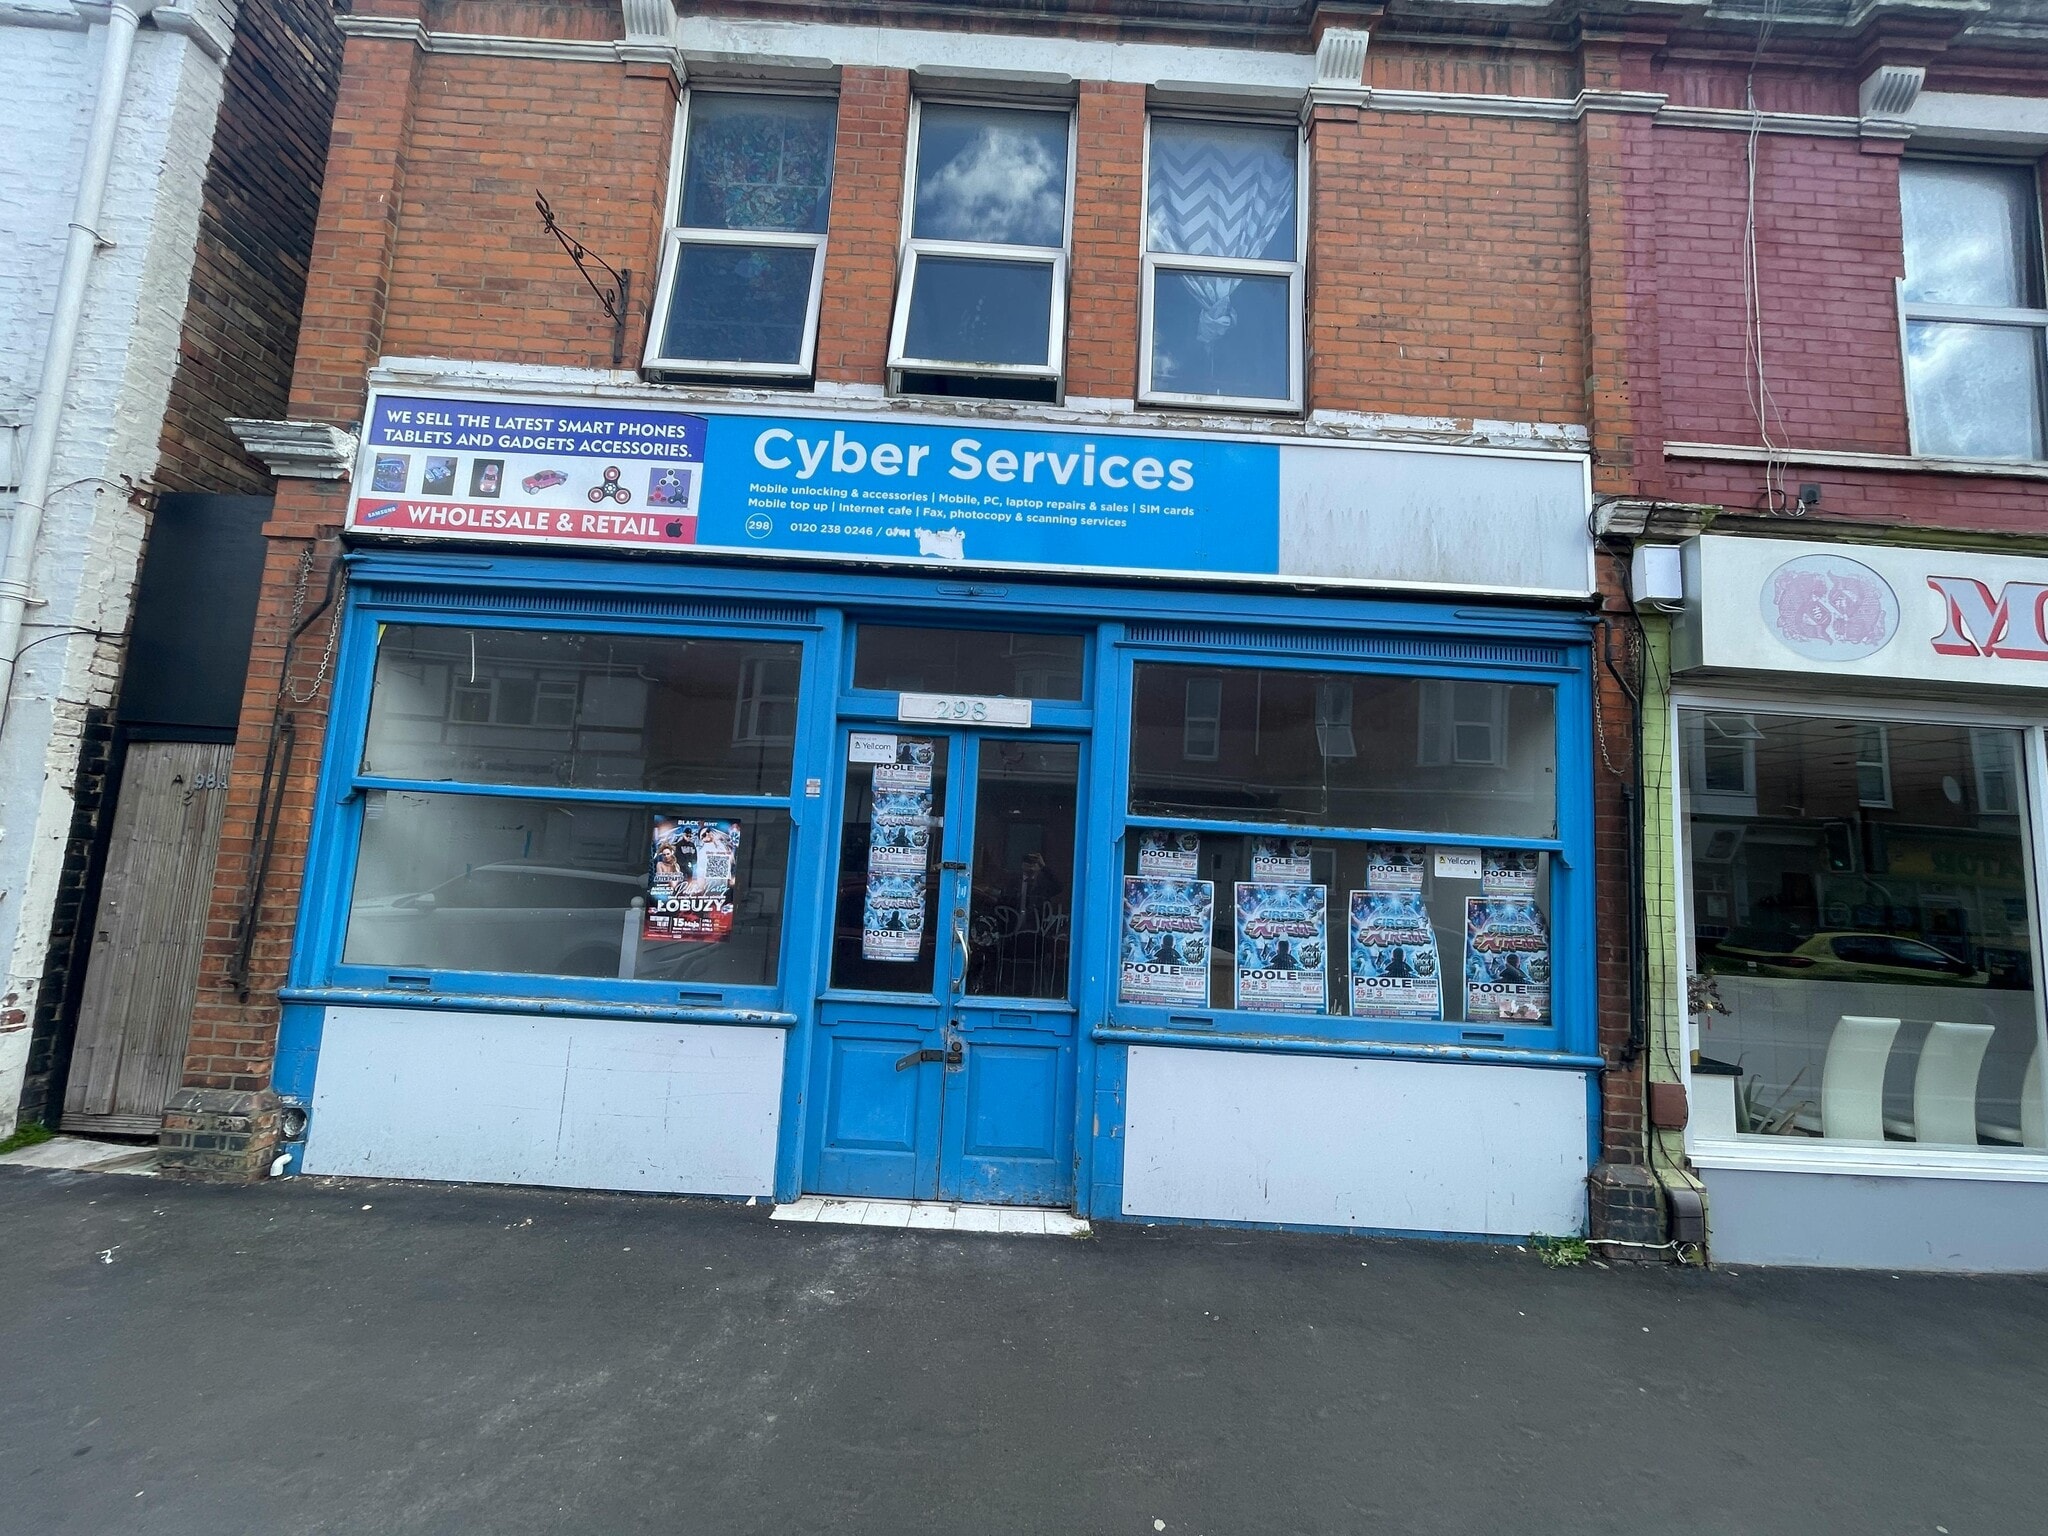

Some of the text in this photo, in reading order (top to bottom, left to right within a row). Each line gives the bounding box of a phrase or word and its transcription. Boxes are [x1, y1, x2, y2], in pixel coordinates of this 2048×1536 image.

[387, 410, 686, 439] WE SELL THE LATEST SMART PHONES
[384, 428, 693, 458] TABLETS AND GADGETS ACCESSORIES.
[753, 427, 1195, 492] Cyber Services
[749, 483, 1195, 516] Mobile unlocking & accessories Mobile, PC, laptop repairs & sales SIM cards
[367, 506, 396, 519] SAMSUNG
[748, 498, 1127, 527] Mobile top up Internet cafe Fax, photocopy & scanning services
[408, 505, 661, 536] WHOLESALE & RETAIL
[749, 520, 770, 531] 298
[790, 522, 817, 533] 0120
[820, 524, 841, 534] 238
[844, 525, 873, 536] 0246
[936, 700, 987, 721] 298
[876, 763, 914, 772] POOLE
[872, 846, 910, 854] POOLE
[1141, 850, 1180, 858] POOLE
[1254, 857, 1292, 865] POOLE
[1484, 870, 1522, 878] POOLE
[1146, 904, 1191, 917] CIRCUS
[1260, 910, 1306, 922] CIRCUS
[673, 918, 684, 927] 15
[1373, 918, 1420, 930] CIRCUS
[865, 930, 903, 939] POOLE
[1487, 924, 1535, 936] CIRCUS
[1123, 962, 1180, 975] POOLE
[1240, 970, 1297, 981] POOLE
[1355, 977, 1412, 988] POOLE
[1469, 983, 1526, 994] POOLE
